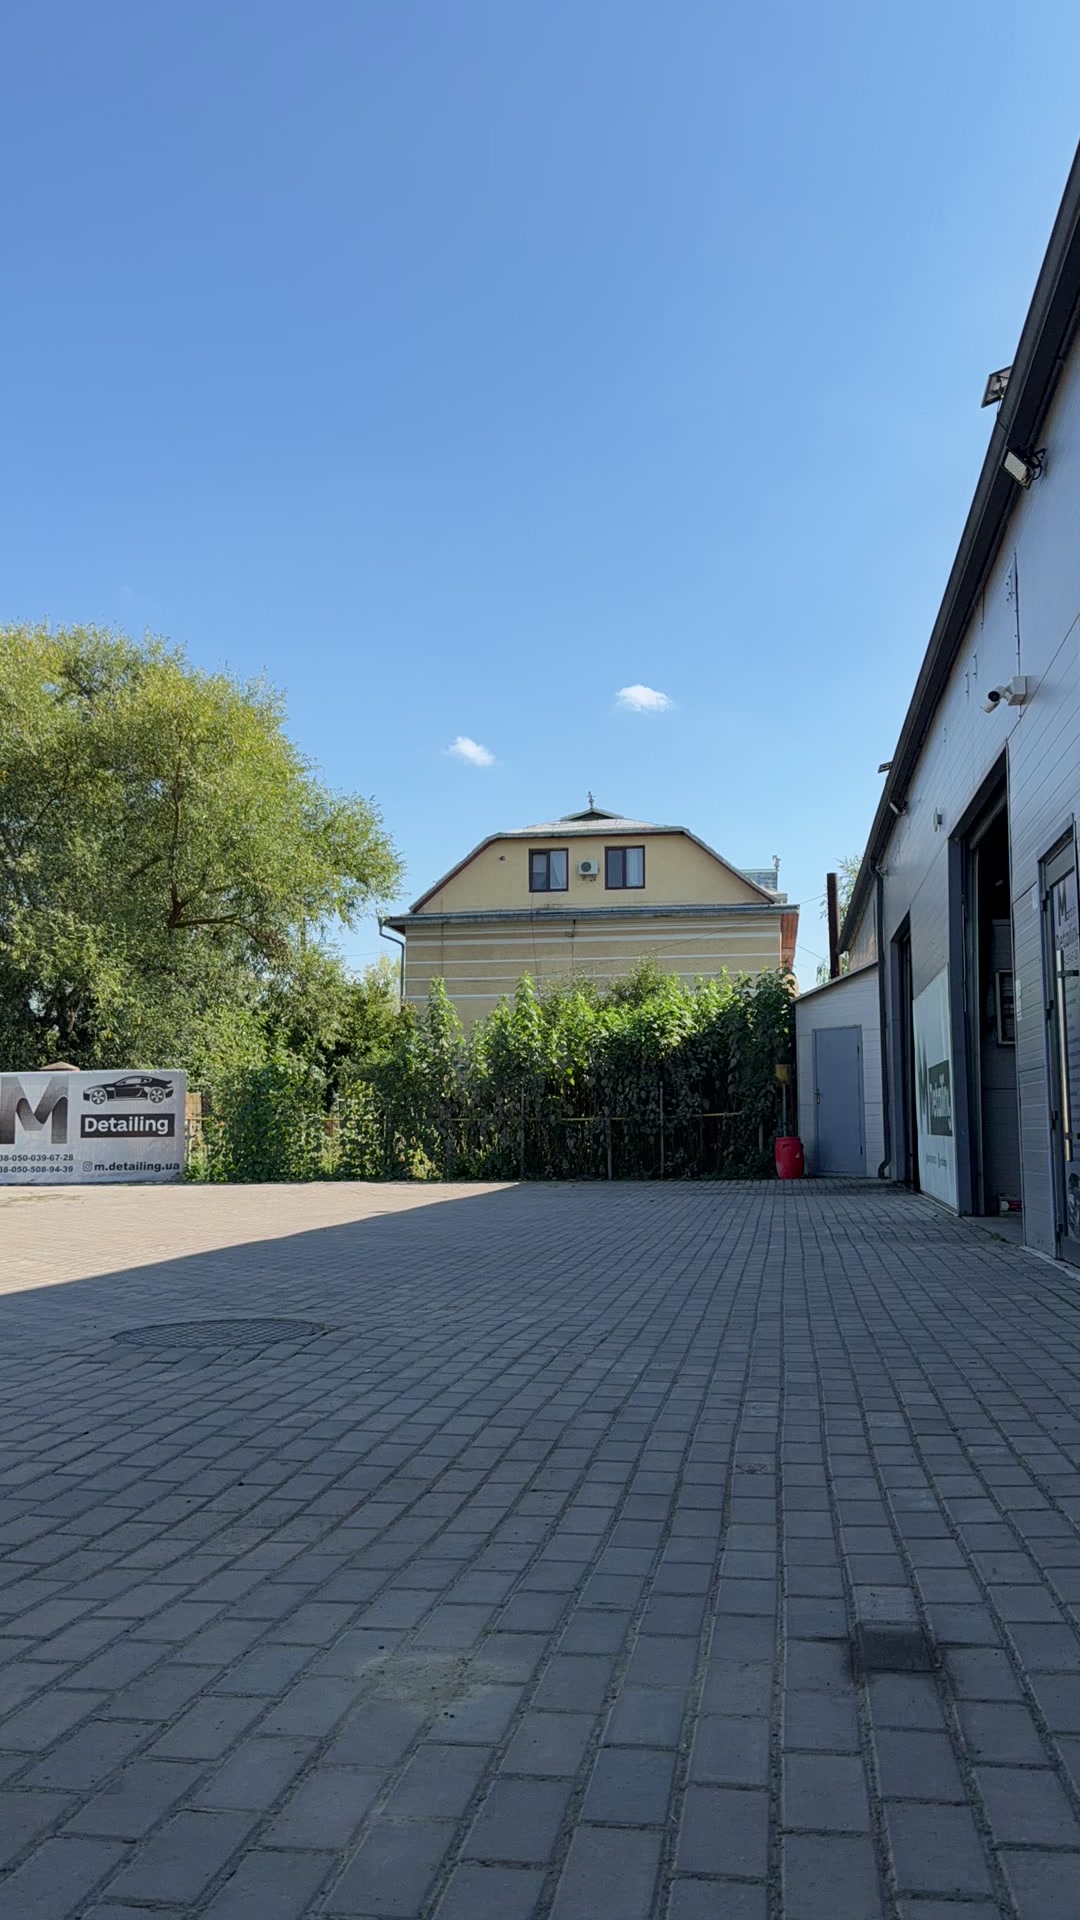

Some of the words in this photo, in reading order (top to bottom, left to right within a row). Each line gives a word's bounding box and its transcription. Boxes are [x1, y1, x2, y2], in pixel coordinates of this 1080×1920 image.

[0, 1076, 69, 1144] M
[84, 1116, 169, 1135] Detailing
[94, 1161, 180, 1173] m.detailing.ua
